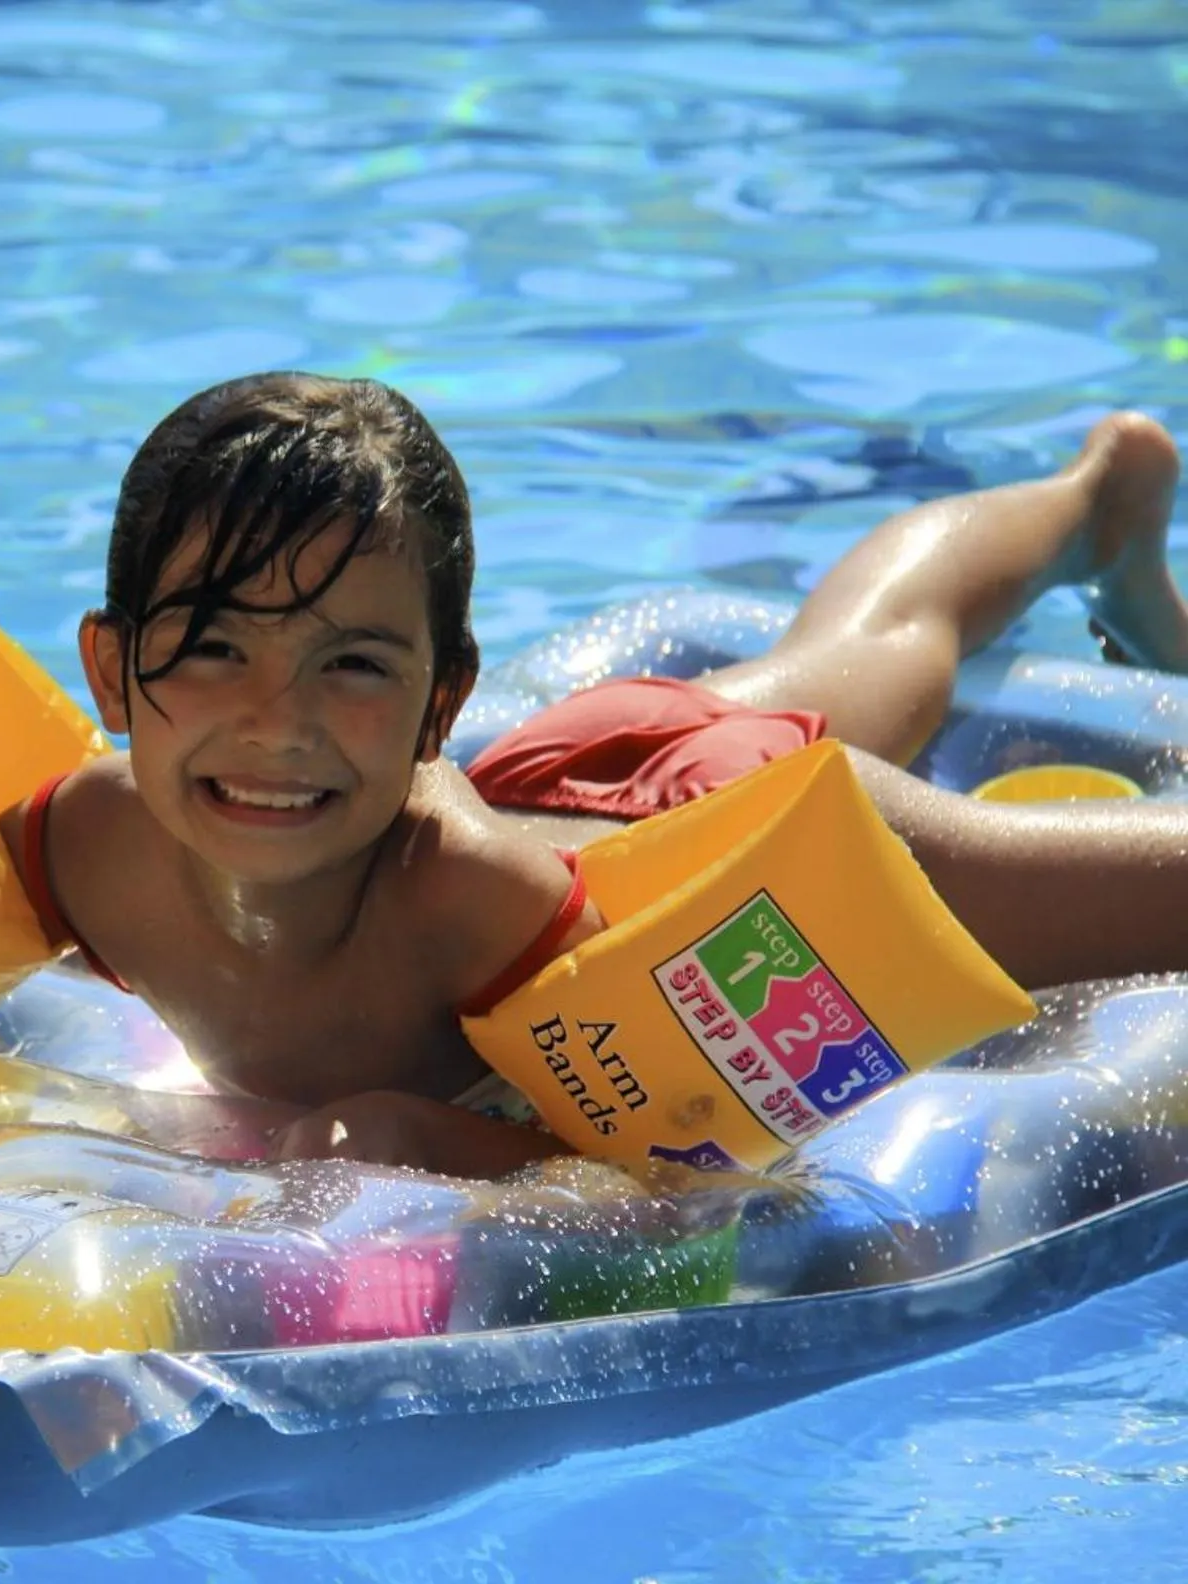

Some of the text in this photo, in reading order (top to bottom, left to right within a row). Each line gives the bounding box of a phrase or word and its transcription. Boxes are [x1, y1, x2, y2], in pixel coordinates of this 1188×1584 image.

[726, 950, 767, 986] 1
[751, 911, 800, 970] step
[668, 961, 738, 1042] STEP
[727, 1045, 774, 1086] BY
[806, 980, 854, 1035] step
[773, 1014, 820, 1057] 2
[529, 1012, 618, 1137] Bands
[576, 1018, 650, 1113] Arm
[821, 1068, 868, 1104] 3
[855, 1042, 894, 1085] step
